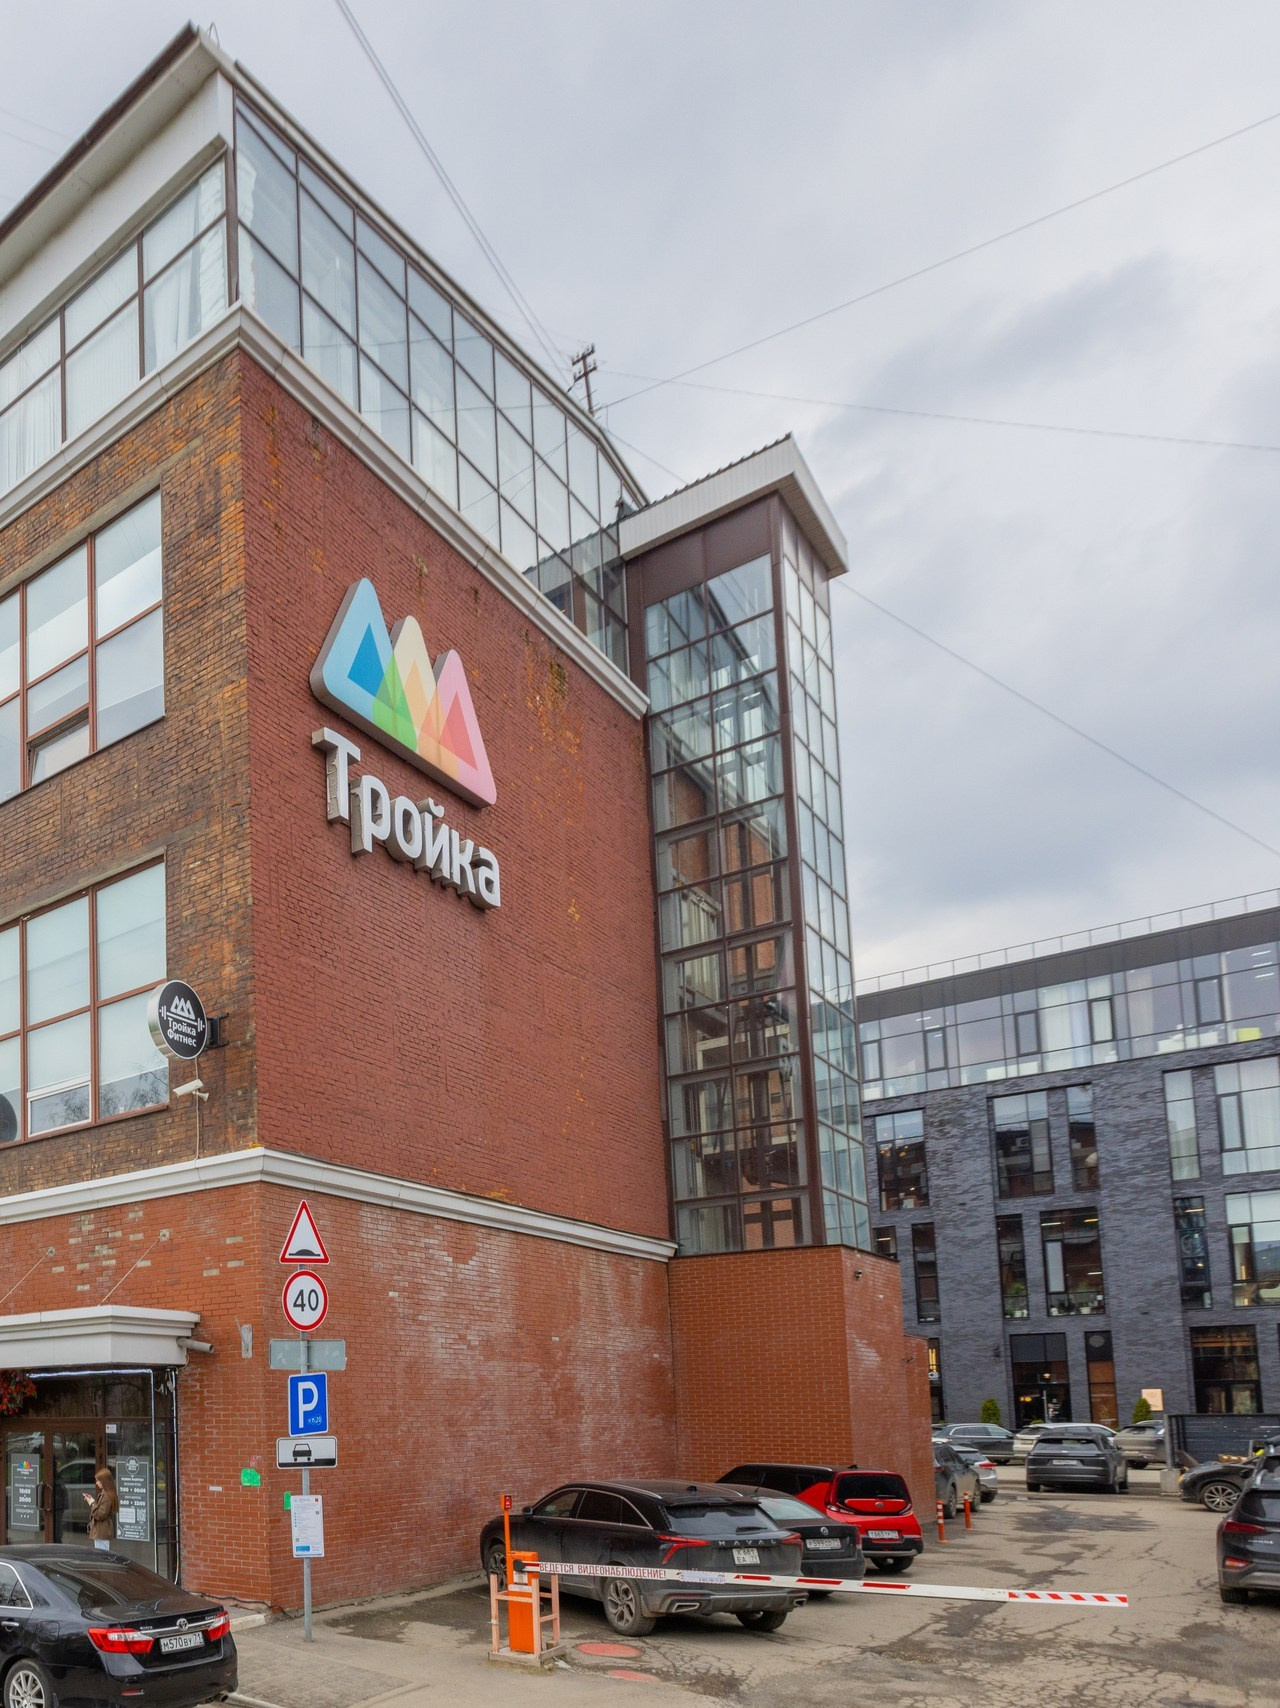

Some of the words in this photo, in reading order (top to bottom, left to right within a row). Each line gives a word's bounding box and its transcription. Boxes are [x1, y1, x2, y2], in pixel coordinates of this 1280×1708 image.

[312, 727, 500, 910] Тройка
[167, 1017, 197, 1036] Тройка
[167, 1028, 197, 1047] Фитнес
[293, 1289, 319, 1312] 40
[298, 1381, 319, 1428] P
[539, 1562, 574, 1574] ВЕДЕТСЯ
[578, 1565, 667, 1580] ВИДЕОНАБЛЮДЕНИЕ!
